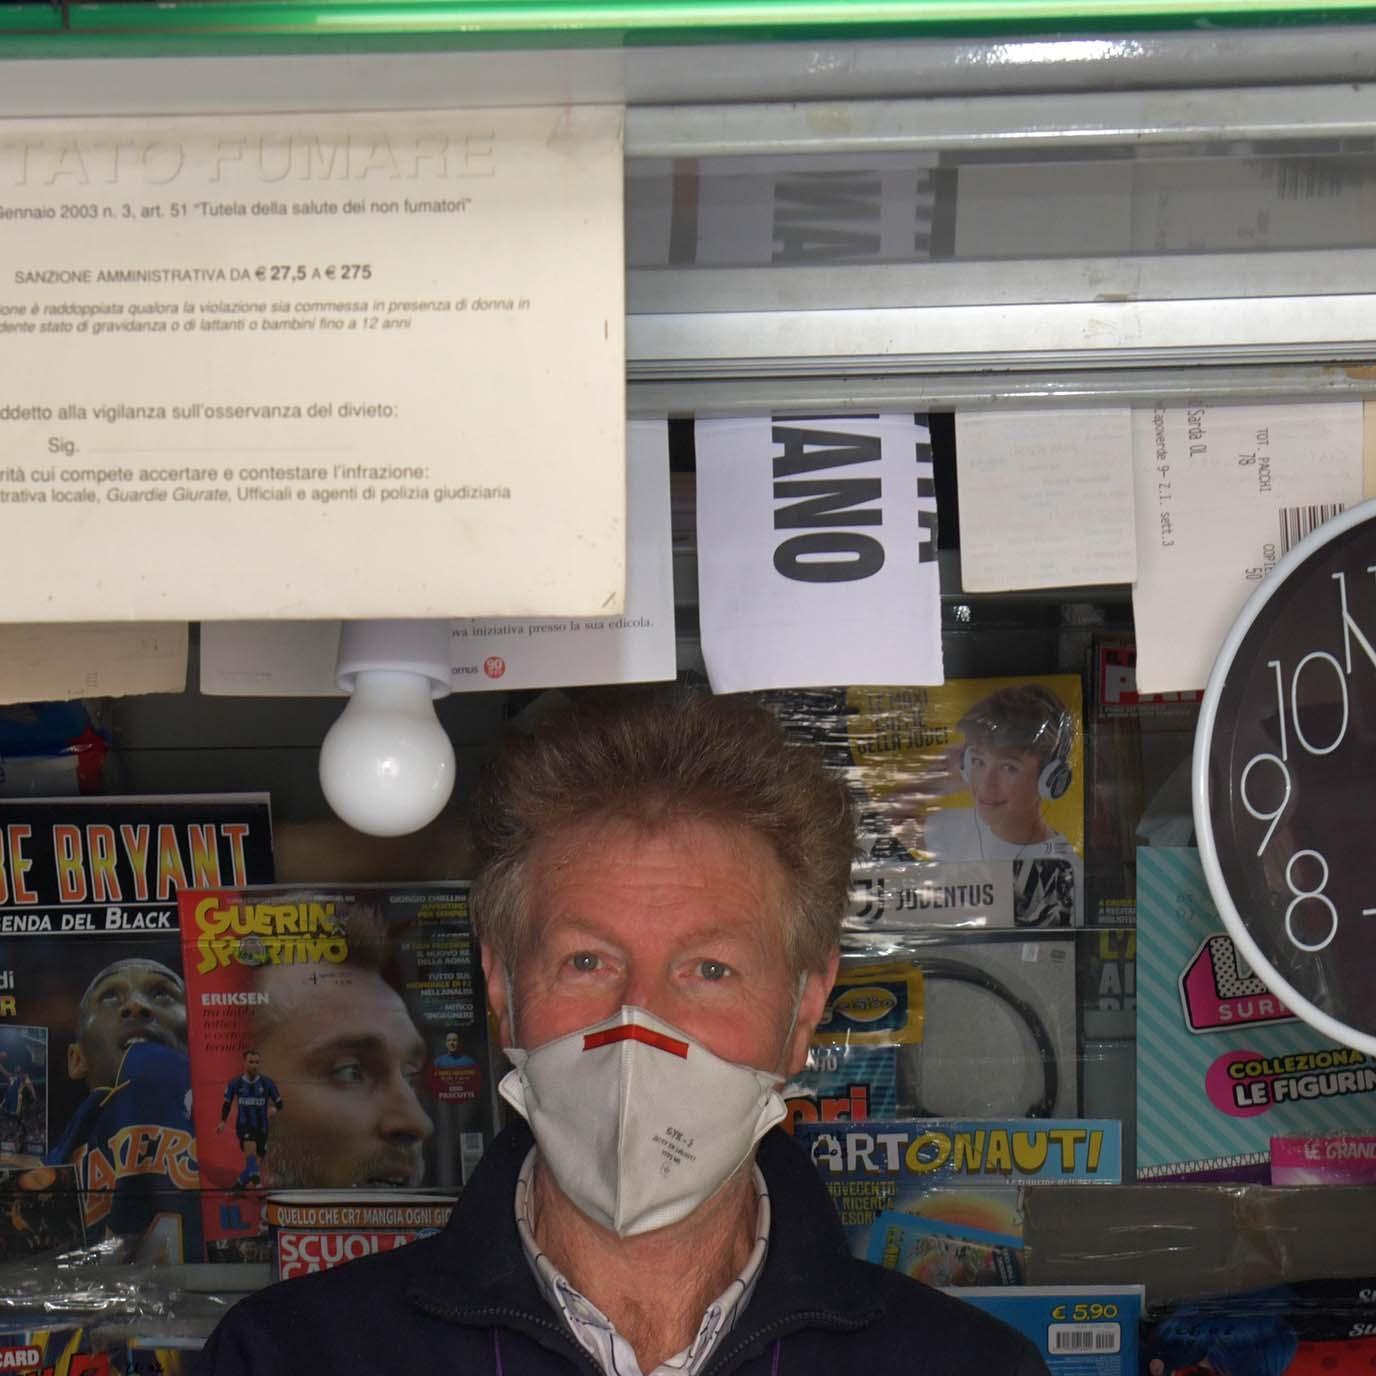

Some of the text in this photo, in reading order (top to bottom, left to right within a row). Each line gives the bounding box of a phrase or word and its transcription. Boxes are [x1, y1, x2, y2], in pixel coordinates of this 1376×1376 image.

[209, 129, 497, 183] FUMARE
[60, 204, 100, 218] 2003
[103, 206, 116, 218] n.
[141, 203, 164, 218] art.
[171, 203, 187, 217] 51
[251, 201, 287, 216] della
[292, 200, 337, 215] salute
[343, 200, 365, 214] dei
[370, 201, 399, 214] non
[15, 269, 92, 285] SANZIONE
[96, 268, 226, 284] AMMINISTRATIVA
[230, 269, 251, 282] DA
[270, 266, 306, 283] 27,5
[311, 267, 322, 279] A
[341, 264, 372, 279] 275
[58, 404, 87, 420] alla
[93, 404, 166, 423] vigilanza
[307, 402, 332, 418] del
[48, 437, 80, 456] Sig.
[1267, 651, 1349, 762] 10
[1240, 752, 1292, 857] 9
[53, 824, 249, 904] BRYANT
[1284, 848, 1338, 952] 8
[201, 992, 270, 1006] ERIKSEN
[1229, 1049, 1363, 1079] COLLEZIONA
[1234, 1083, 1269, 1107] LE
[811, 1128, 1103, 1175] ARTONAUTI
